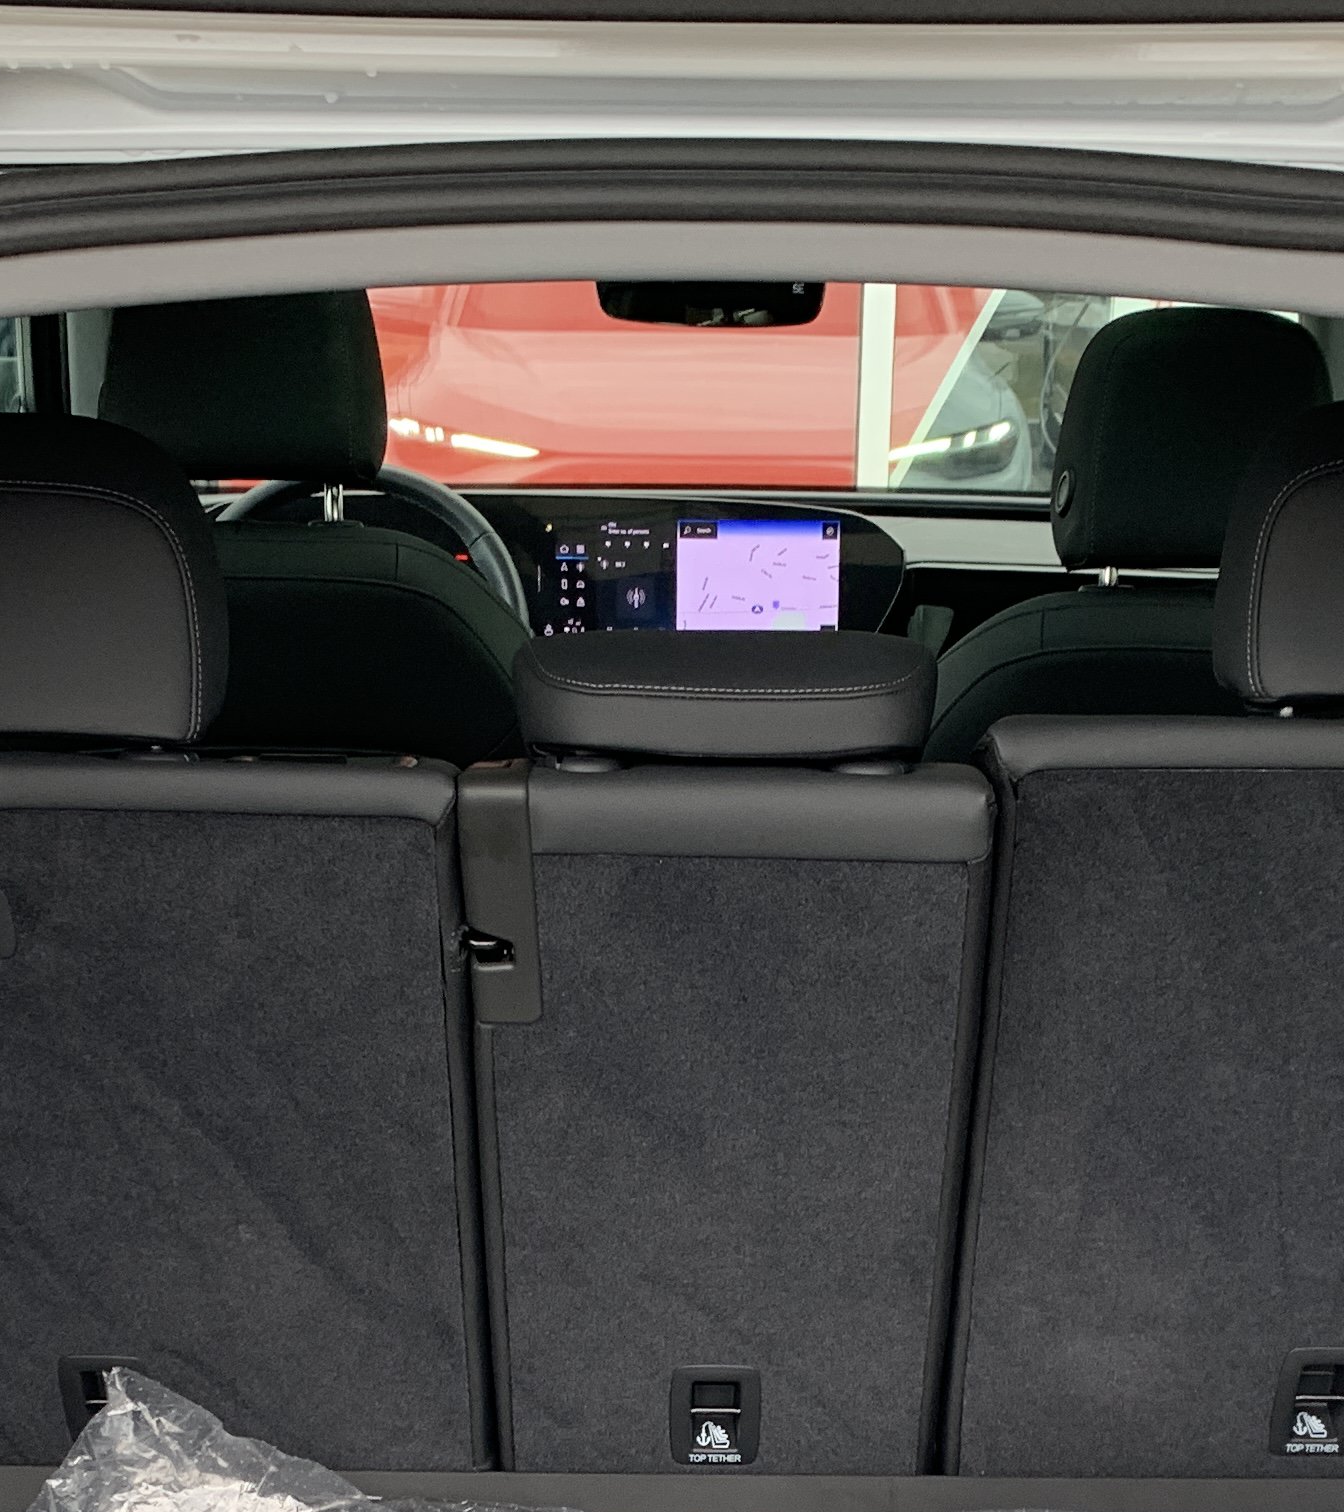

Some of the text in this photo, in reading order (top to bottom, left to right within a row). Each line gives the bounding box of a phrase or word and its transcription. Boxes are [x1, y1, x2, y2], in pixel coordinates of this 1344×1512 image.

[1285, 1443, 1339, 1453] TOP TETHER
[688, 1454, 742, 1463] TOP TETHER
